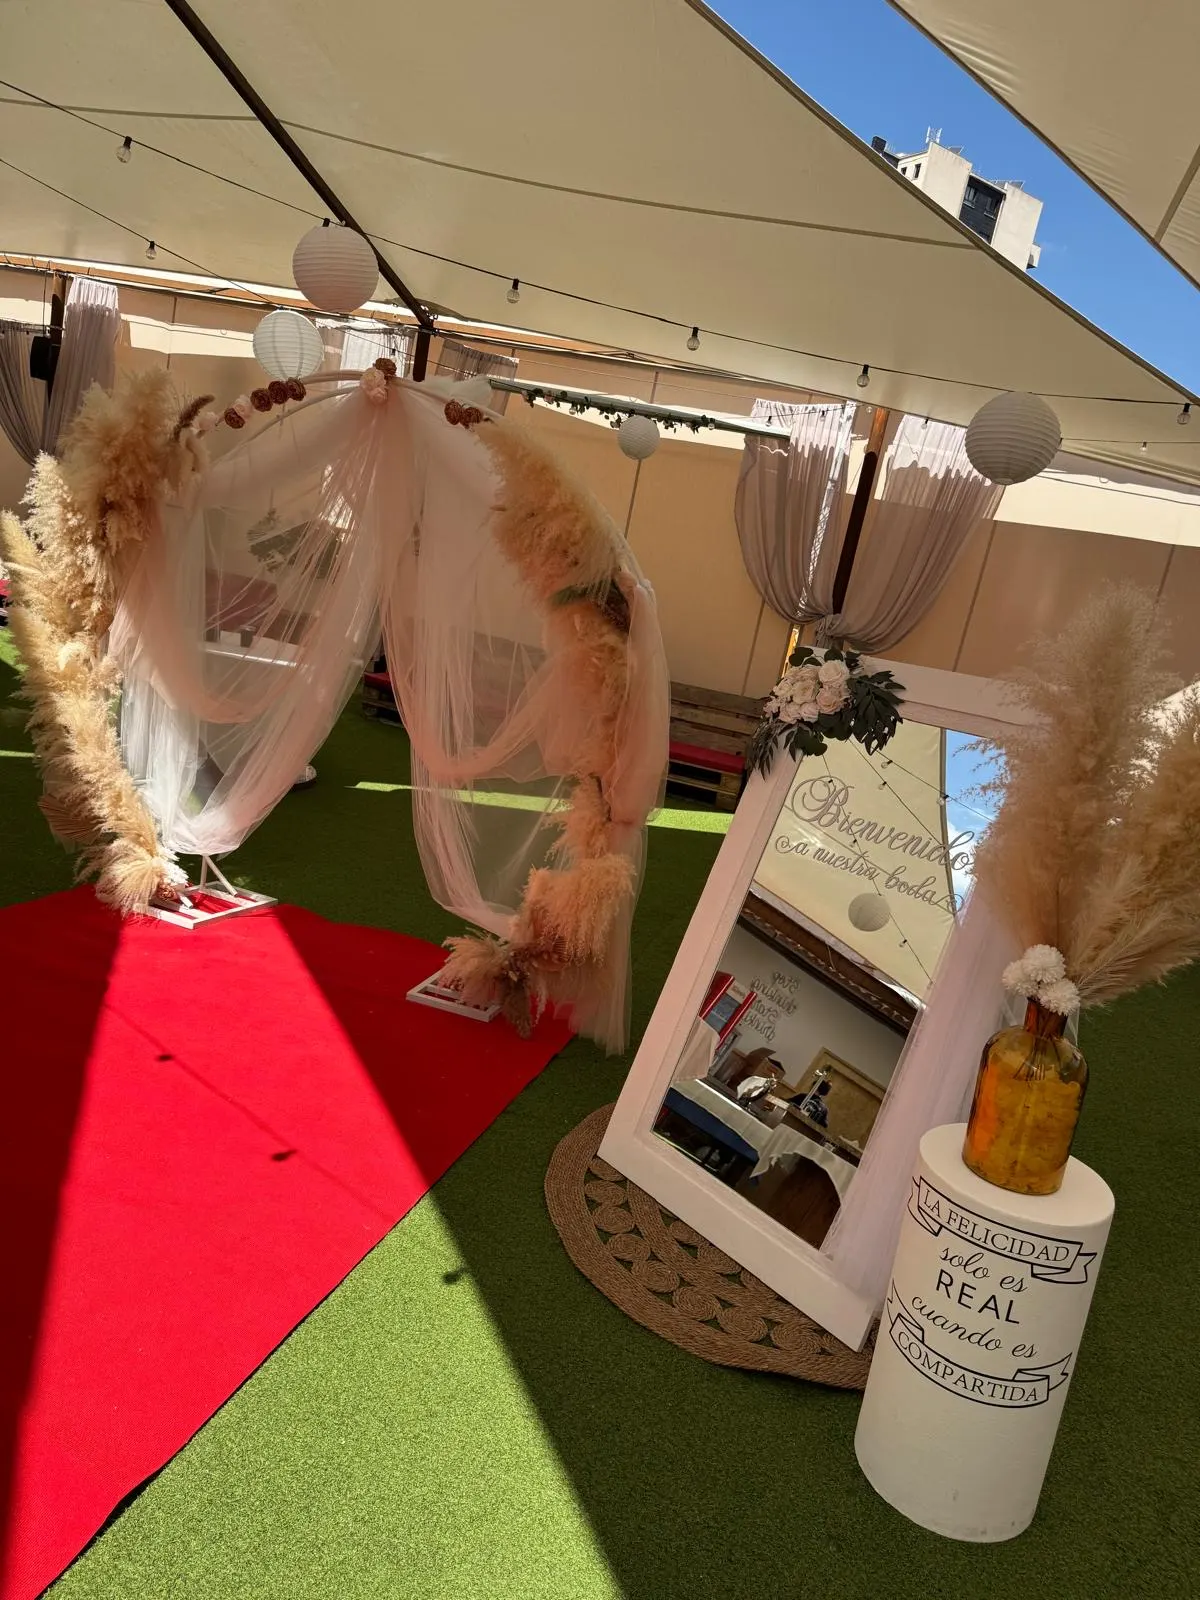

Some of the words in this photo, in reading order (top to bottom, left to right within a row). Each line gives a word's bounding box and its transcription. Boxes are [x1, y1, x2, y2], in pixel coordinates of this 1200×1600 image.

[792, 775, 975, 871] Bienvenido
[812, 847, 880, 881] nuestra
[884, 865, 964, 914] boda
[923, 1189, 941, 1217] LA
[946, 1209, 1070, 1262] FELICIDAD
[936, 1268, 1021, 1324] REAL
[939, 1247, 990, 1279] solo
[999, 1275, 1028, 1293] es
[911, 1295, 1003, 1351] cuando
[1011, 1343, 1038, 1358] es
[898, 1331, 1039, 1402] COMPARTIDA
